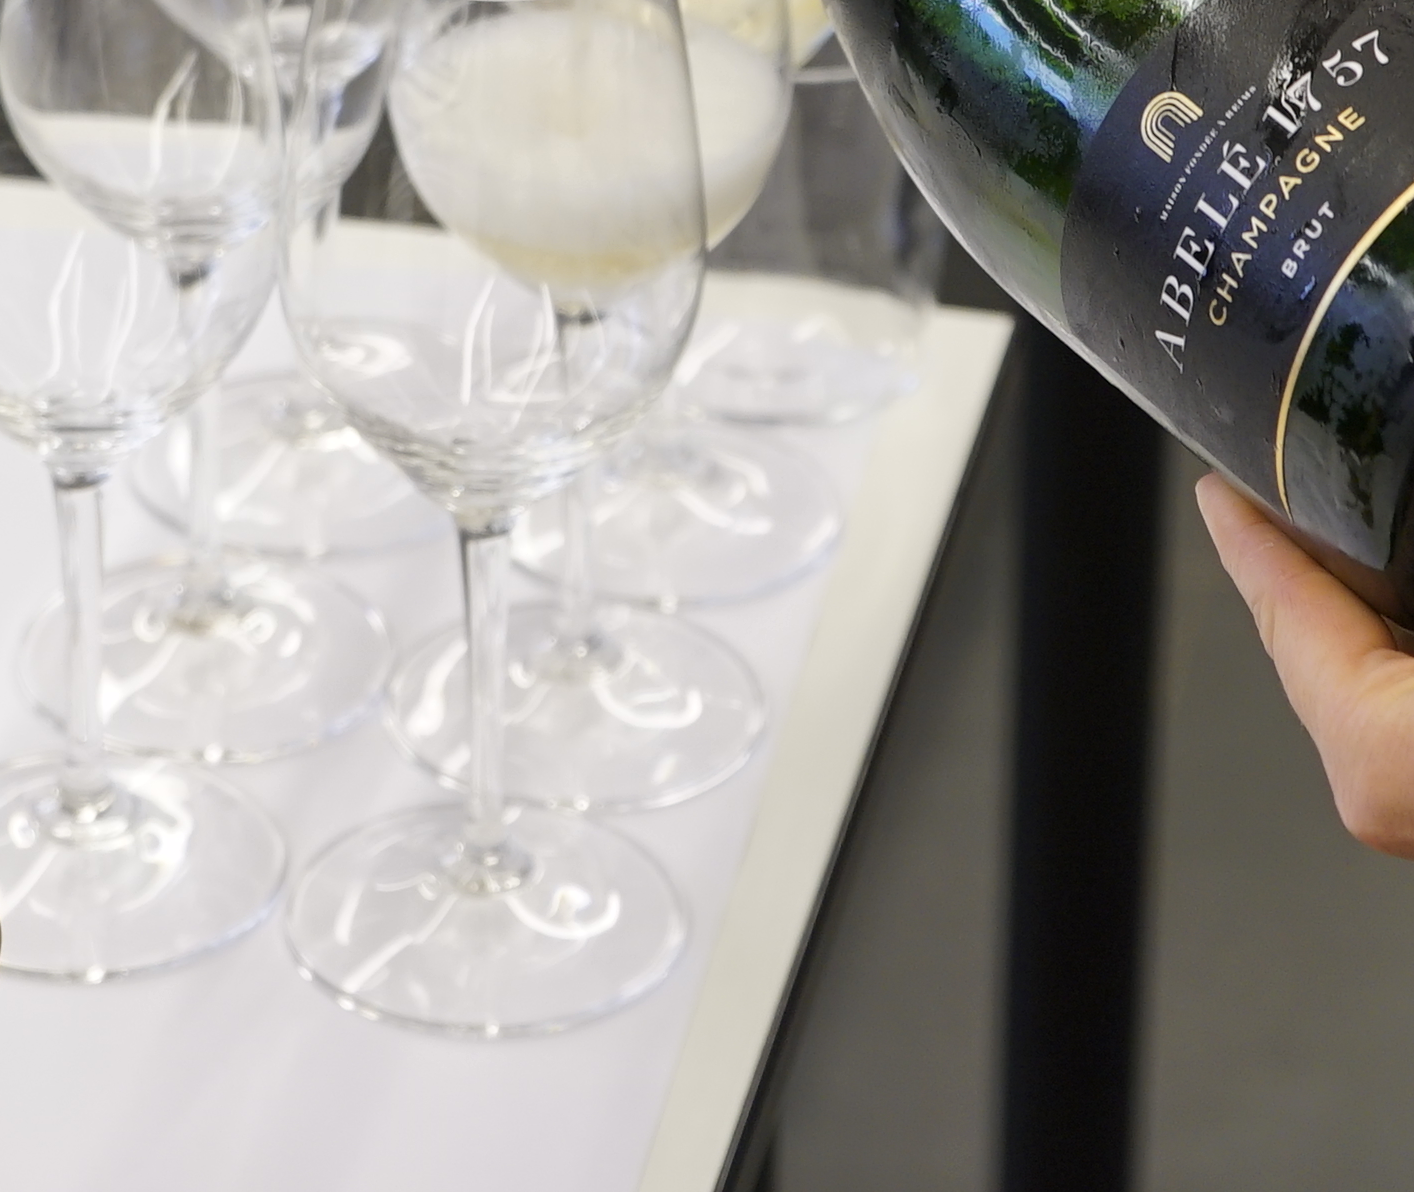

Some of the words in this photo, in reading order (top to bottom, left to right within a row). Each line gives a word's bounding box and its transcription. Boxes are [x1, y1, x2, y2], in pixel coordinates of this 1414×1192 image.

[1153, 140, 1268, 374] ABELÉ
[1262, 29, 1390, 139] 1757
[1160, 176, 1187, 222] MAISON
[1208, 106, 1367, 327] CHAMPAGNE
[1280, 200, 1336, 280] BRUT
